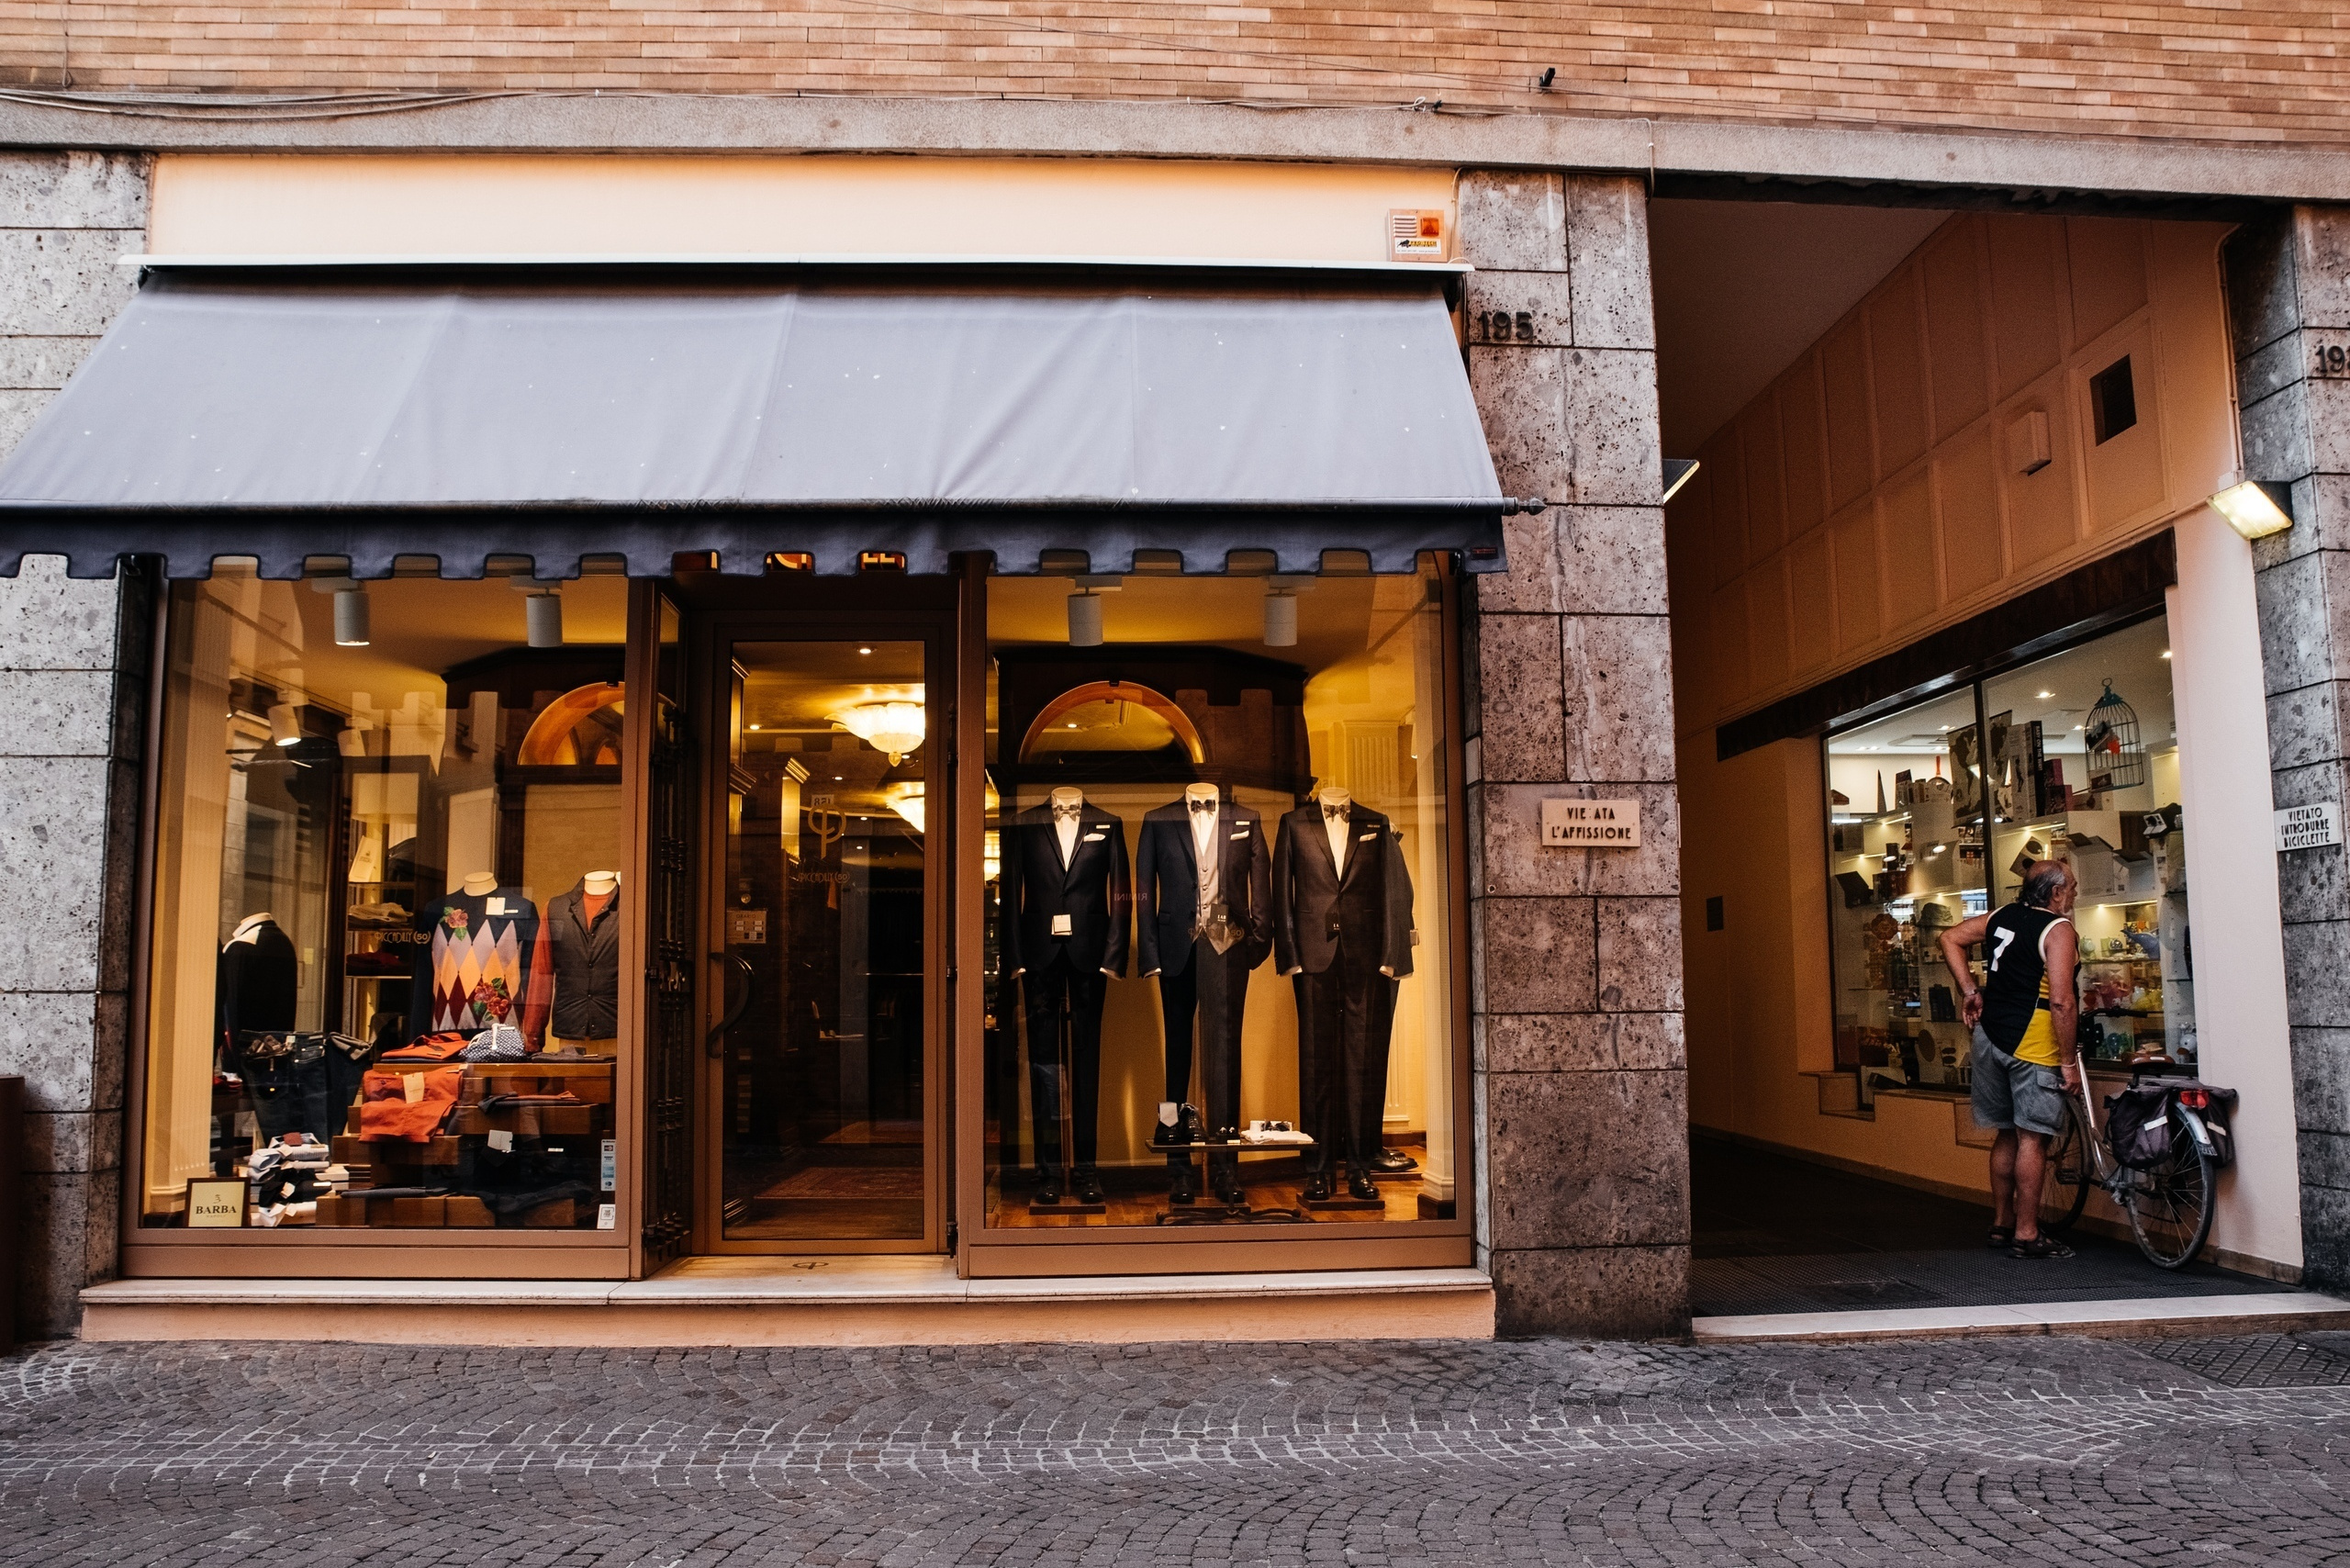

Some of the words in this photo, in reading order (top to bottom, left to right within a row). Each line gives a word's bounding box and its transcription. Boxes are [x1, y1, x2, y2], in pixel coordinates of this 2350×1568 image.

[1477, 311, 1534, 341] 195
[2314, 345, 2350, 373] 19
[1567, 807, 1616, 820] VIEATA
[2288, 807, 2322, 822] VIETATO
[1551, 826, 1632, 839] L'AFFISSIONE
[2281, 818, 2329, 835] INTRODURRE
[2284, 832, 2330, 847] BICICLETTE
[1990, 926, 2016, 972] 7
[196, 1205, 237, 1215] BARBA
